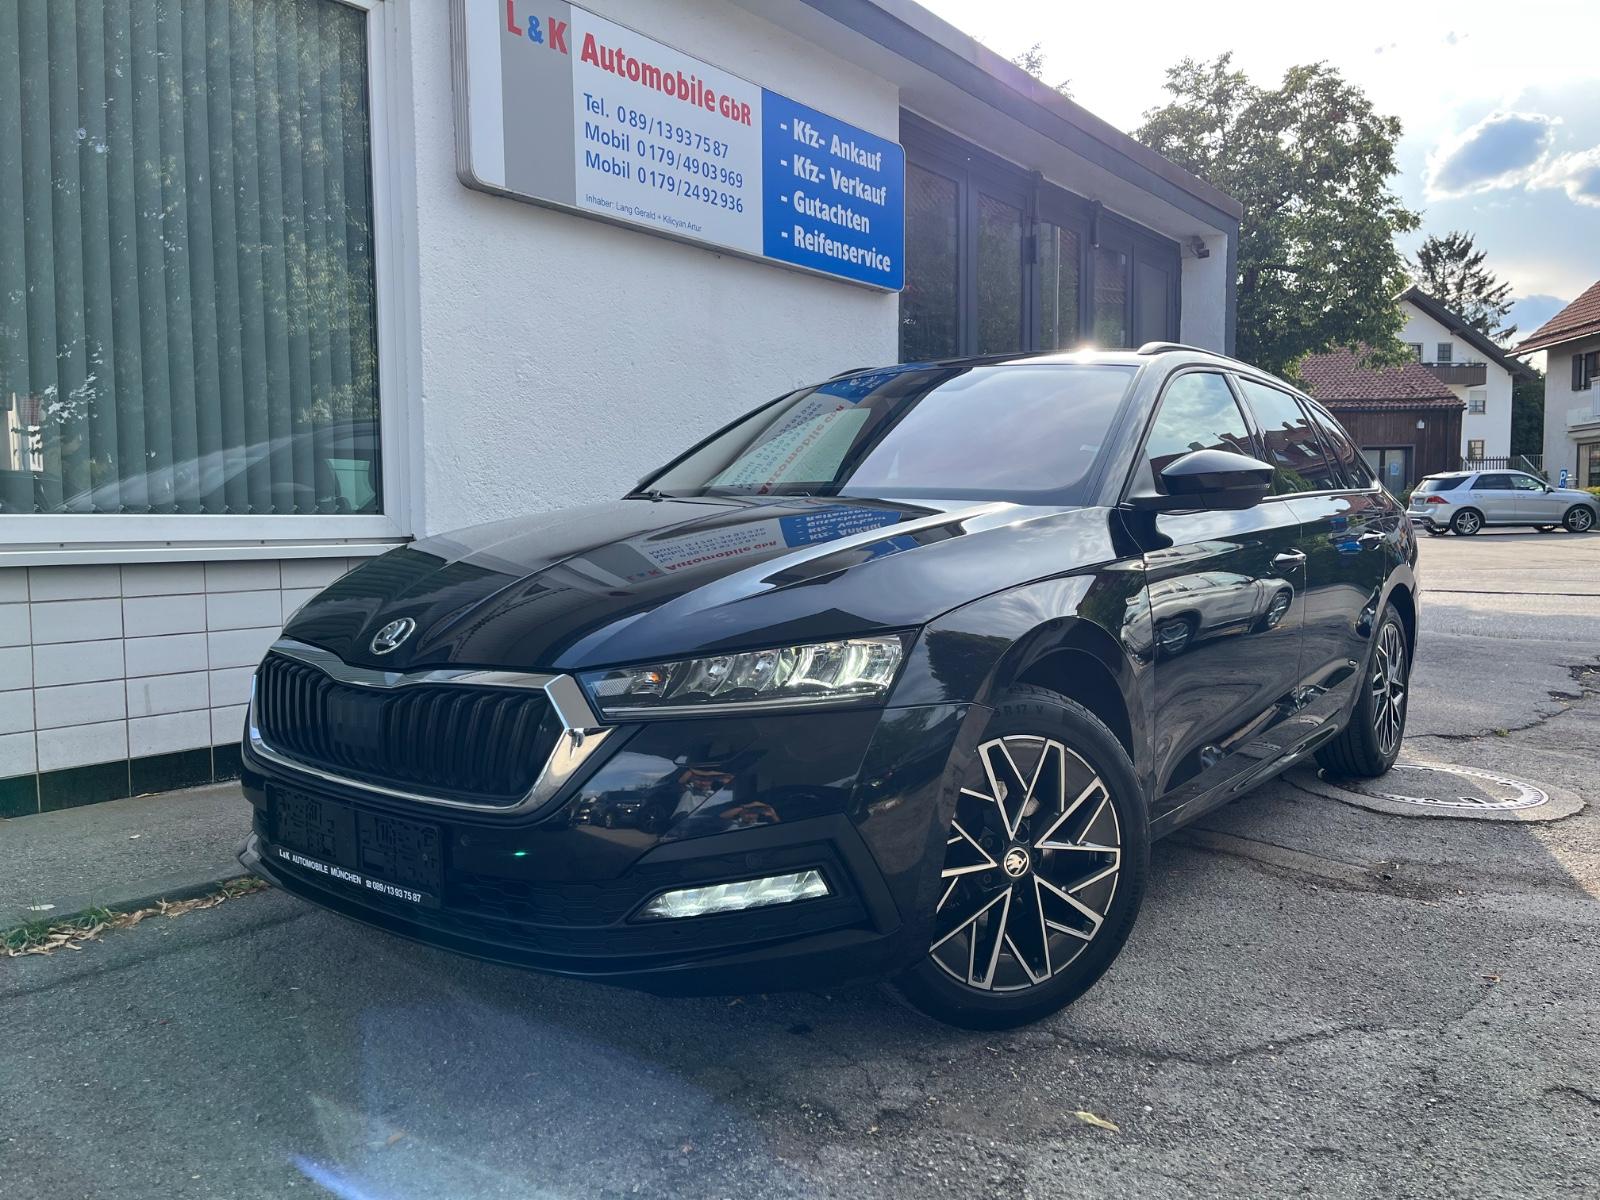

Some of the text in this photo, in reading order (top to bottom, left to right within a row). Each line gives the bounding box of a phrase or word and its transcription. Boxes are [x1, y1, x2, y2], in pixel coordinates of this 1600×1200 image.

[506, 0, 752, 127] L & K Automobile GbR
[583, 93, 609, 118] Tel.
[585, 121, 630, 152] Mobil
[793, 118, 826, 149] Kfz-
[830, 134, 882, 172] Ankauf
[585, 150, 630, 179] Mobil
[793, 154, 826, 184] Kfz-
[830, 167, 886, 206] Verkauf
[585, 193, 614, 208] Inhaber:
[615, 202, 633, 216] Lang
[634, 207, 656, 220] Gerald
[793, 190, 870, 234] Gutachten
[793, 225, 891, 272] Reifenservice
[292, 854, 329, 874] AUTOMOBILE
[330, 866, 362, 885] MÜNCHEN
